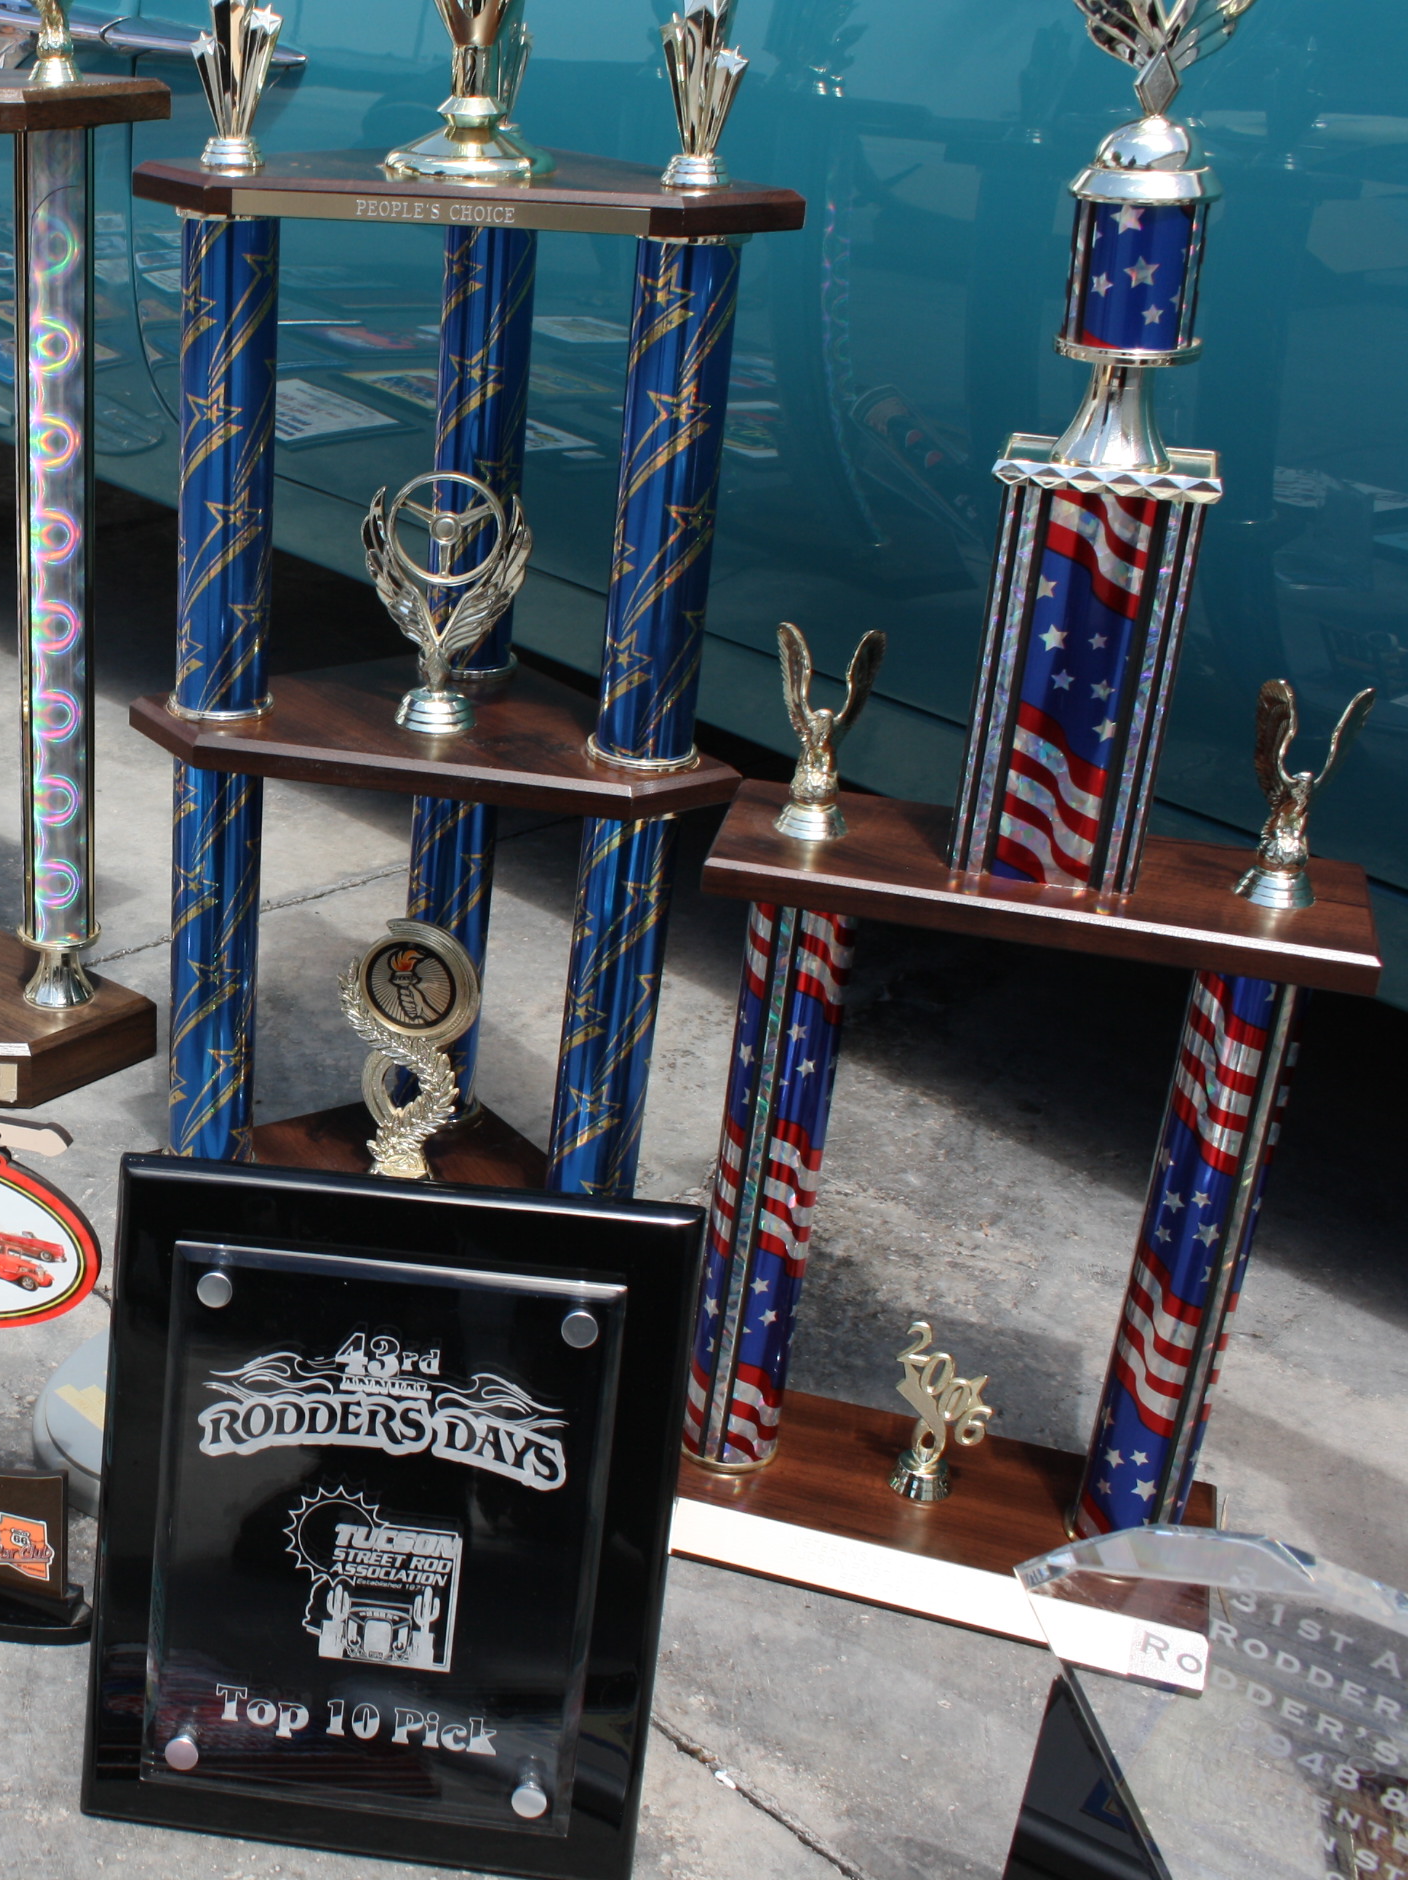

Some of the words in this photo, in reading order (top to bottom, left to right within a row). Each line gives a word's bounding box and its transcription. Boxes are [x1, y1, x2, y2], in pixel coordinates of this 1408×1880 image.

[355, 199, 440, 220] PEOPLE'S
[449, 204, 515, 223] CHOICE
[334, 1332, 441, 1377] 43rd
[895, 1321, 993, 1447] 2006
[204, 1396, 430, 1452] RODDERS
[440, 1410, 563, 1486] DAYS
[332, 1547, 406, 1571] STREET
[409, 1555, 453, 1575] ROD
[334, 1523, 462, 1559] TUCSON
[328, 1561, 448, 1587] ASSOCIATION
[355, 1576, 404, 1589] Established
[1228, 1590, 1354, 1653] 31ST
[215, 1682, 310, 1739] Top
[325, 1698, 382, 1741] 10
[392, 1706, 498, 1756] Pick
